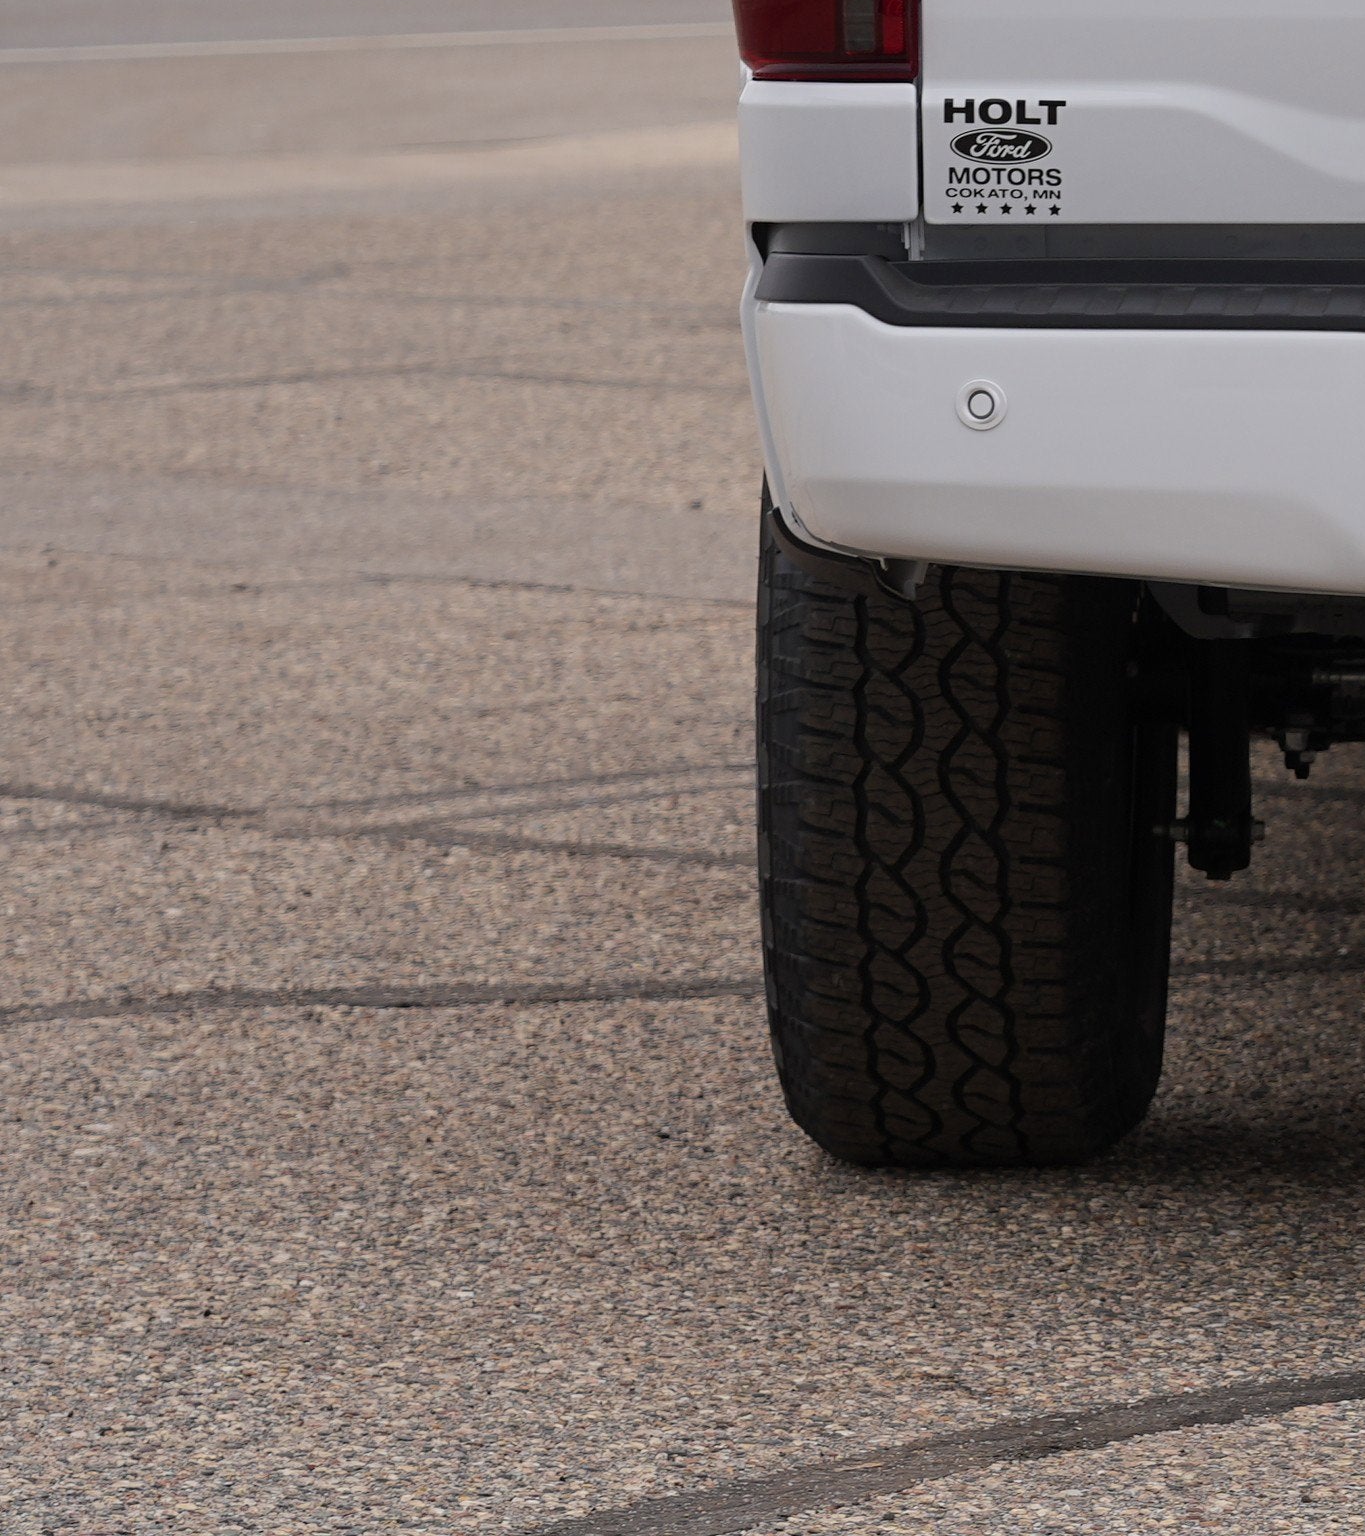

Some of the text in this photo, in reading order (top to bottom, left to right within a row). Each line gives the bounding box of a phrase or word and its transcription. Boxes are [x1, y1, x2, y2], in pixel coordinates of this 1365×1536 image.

[943, 98, 1067, 126] HOLT
[969, 132, 1033, 159] Ford
[948, 166, 1063, 187] MOTORS
[945, 187, 1062, 202] COKATO, MN
